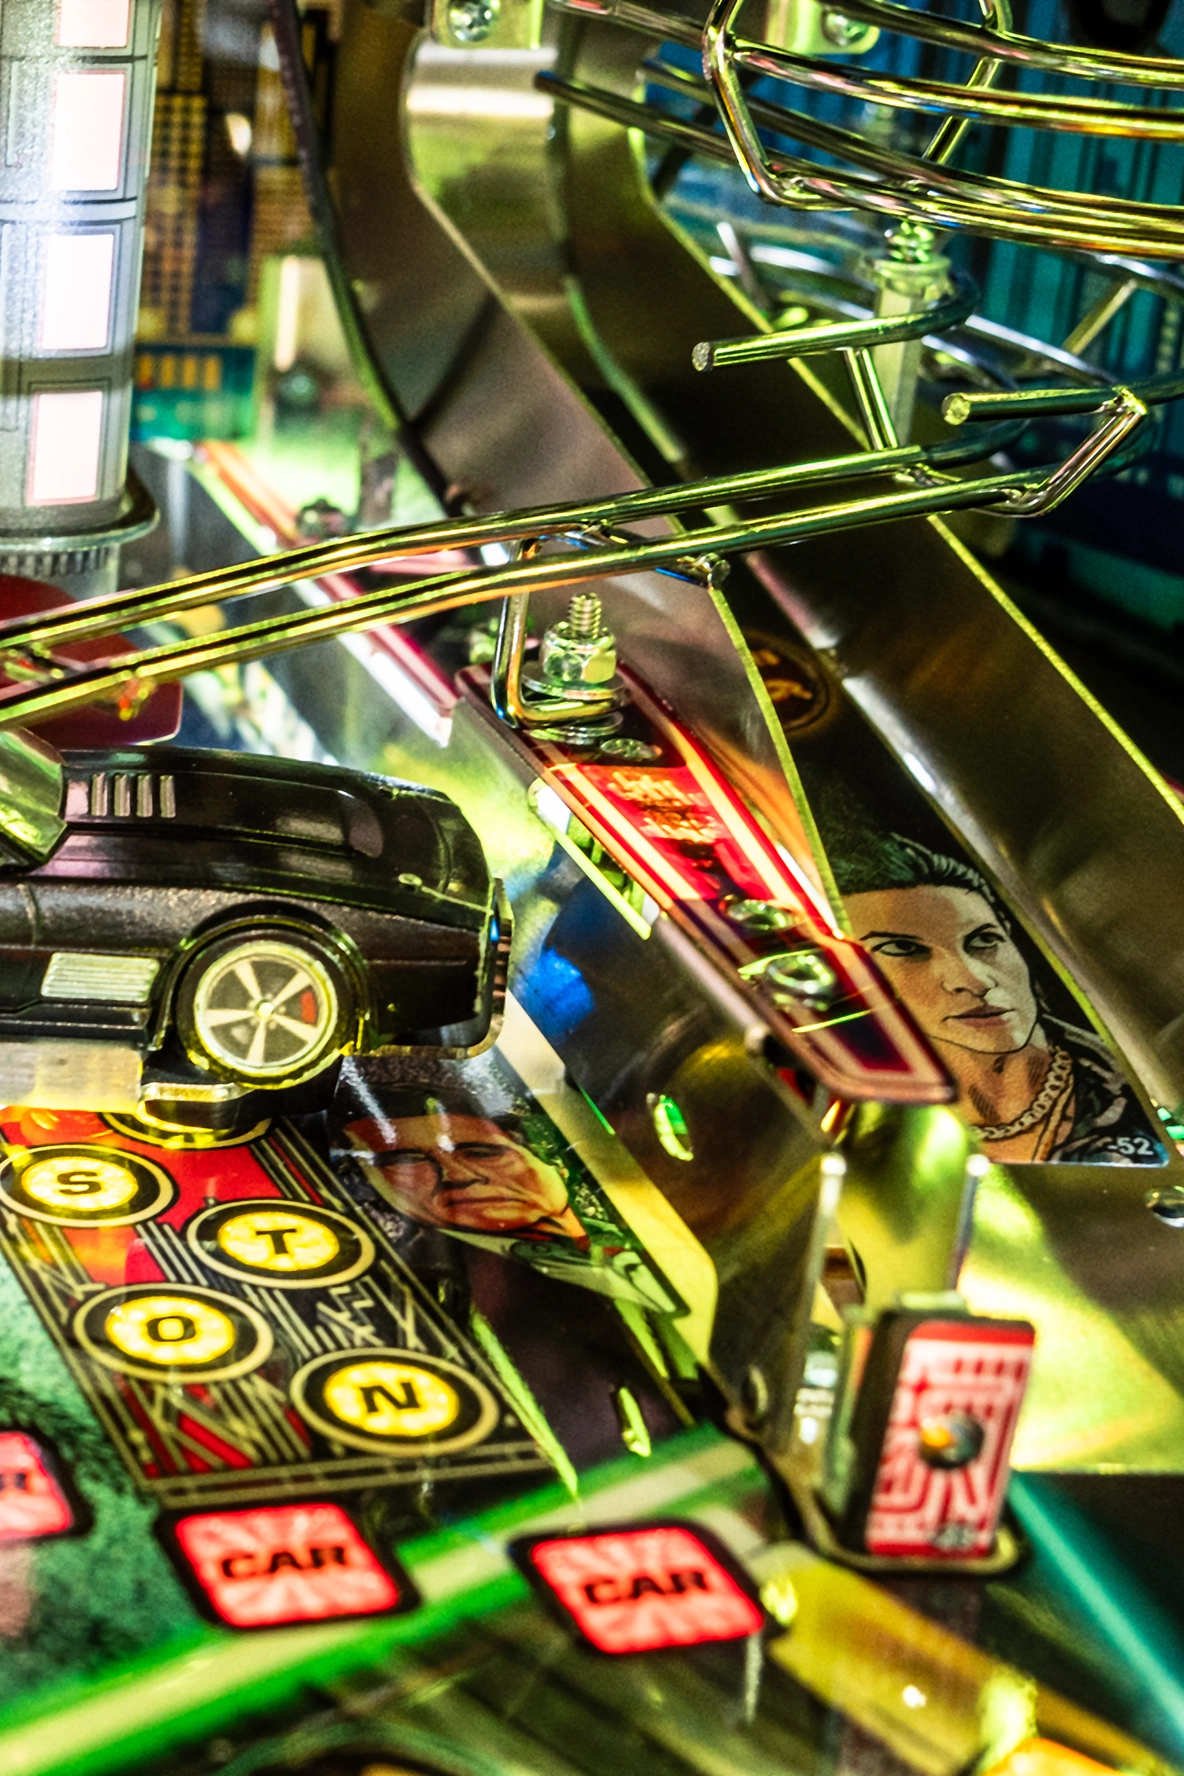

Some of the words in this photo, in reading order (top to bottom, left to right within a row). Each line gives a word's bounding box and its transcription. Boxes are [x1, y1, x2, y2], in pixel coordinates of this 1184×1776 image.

[1107, 1136, 1155, 1156] -52
[56, 1171, 102, 1196] S
[255, 1228, 297, 1255] T
[146, 1315, 196, 1343] O
[360, 1381, 421, 1414] N
[221, 1545, 346, 1578] CAR
[583, 1571, 708, 1605] CAR
